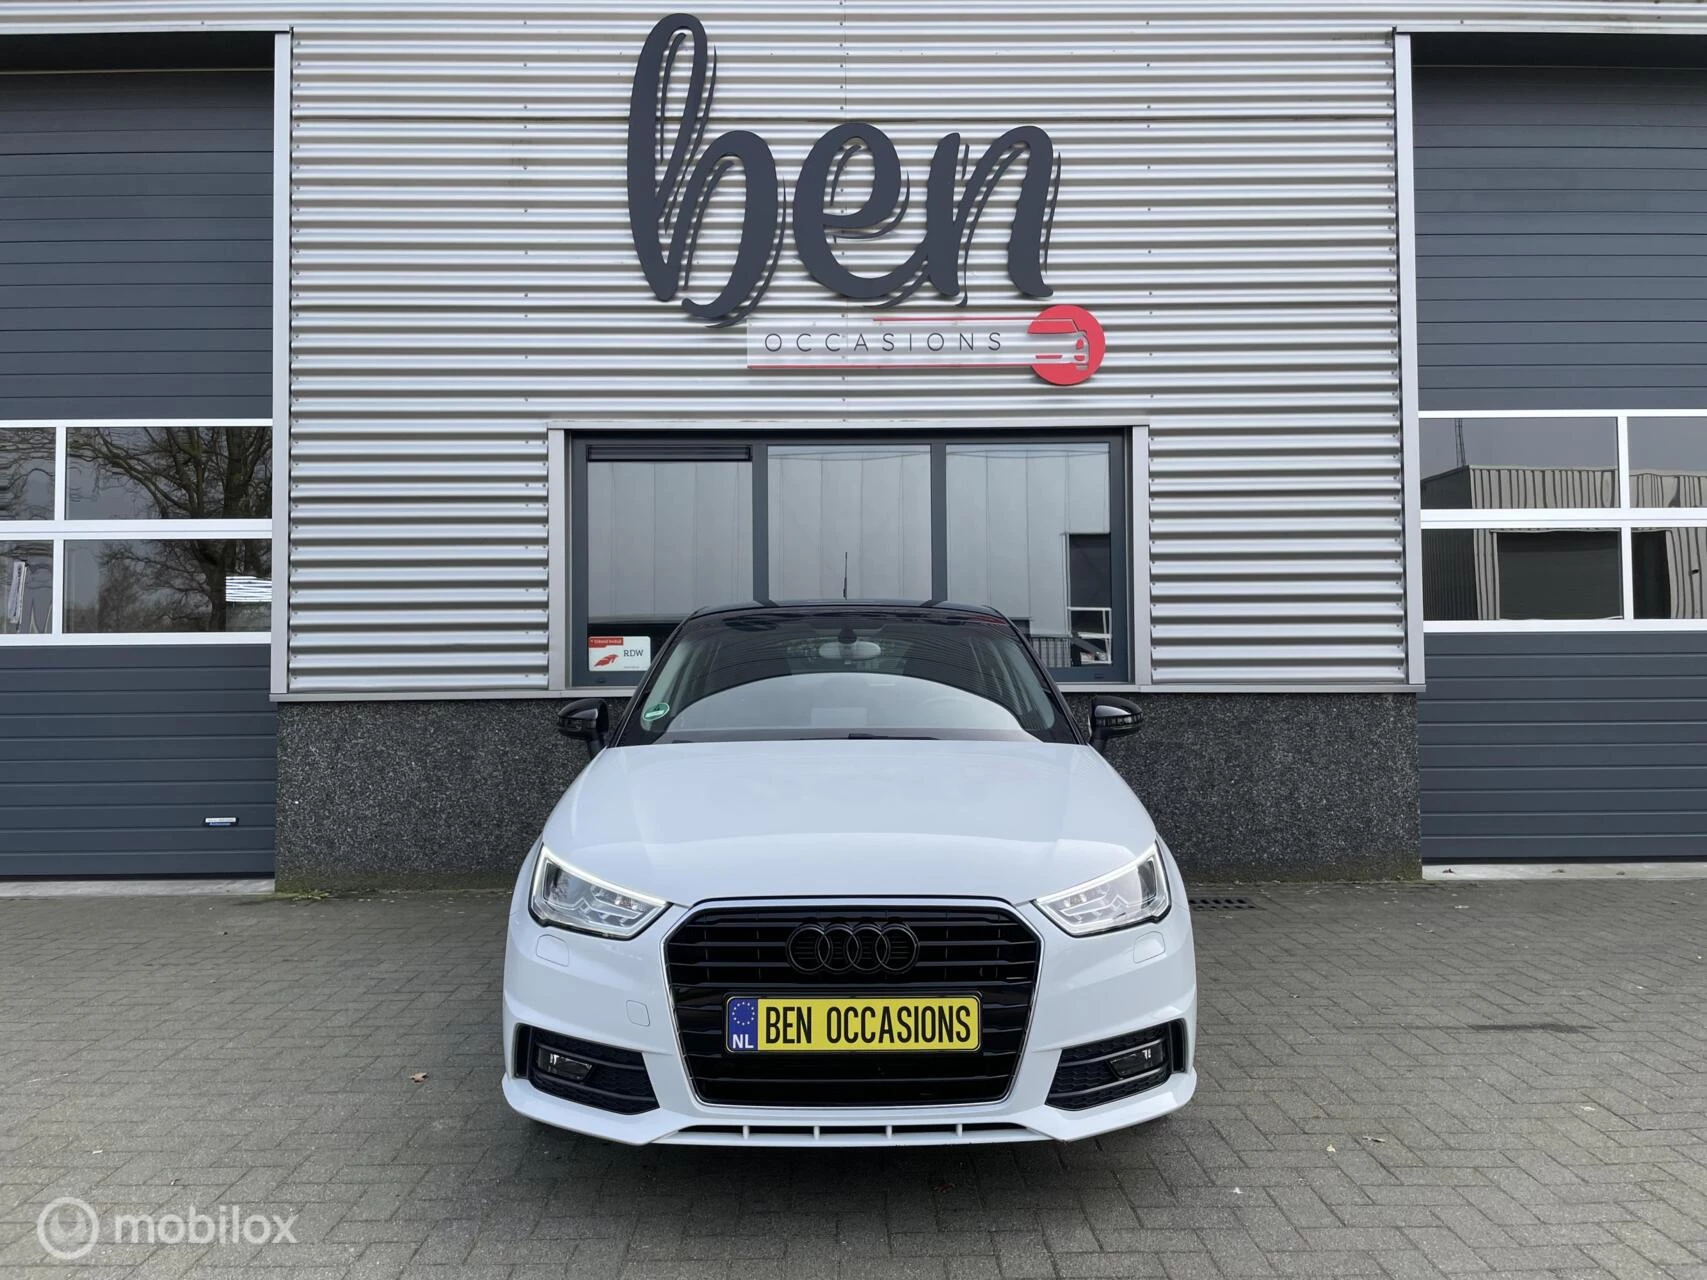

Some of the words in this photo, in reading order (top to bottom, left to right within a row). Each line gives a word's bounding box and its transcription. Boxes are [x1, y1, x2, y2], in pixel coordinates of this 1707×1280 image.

[627, 13, 1055, 321] ben
[764, 332, 1001, 353] OCCASIONS
[623, 649, 644, 657] RDW
[765, 1006, 812, 1044] BEN
[826, 1005, 971, 1044] OCCASIONS
[732, 1034, 754, 1049] NL
